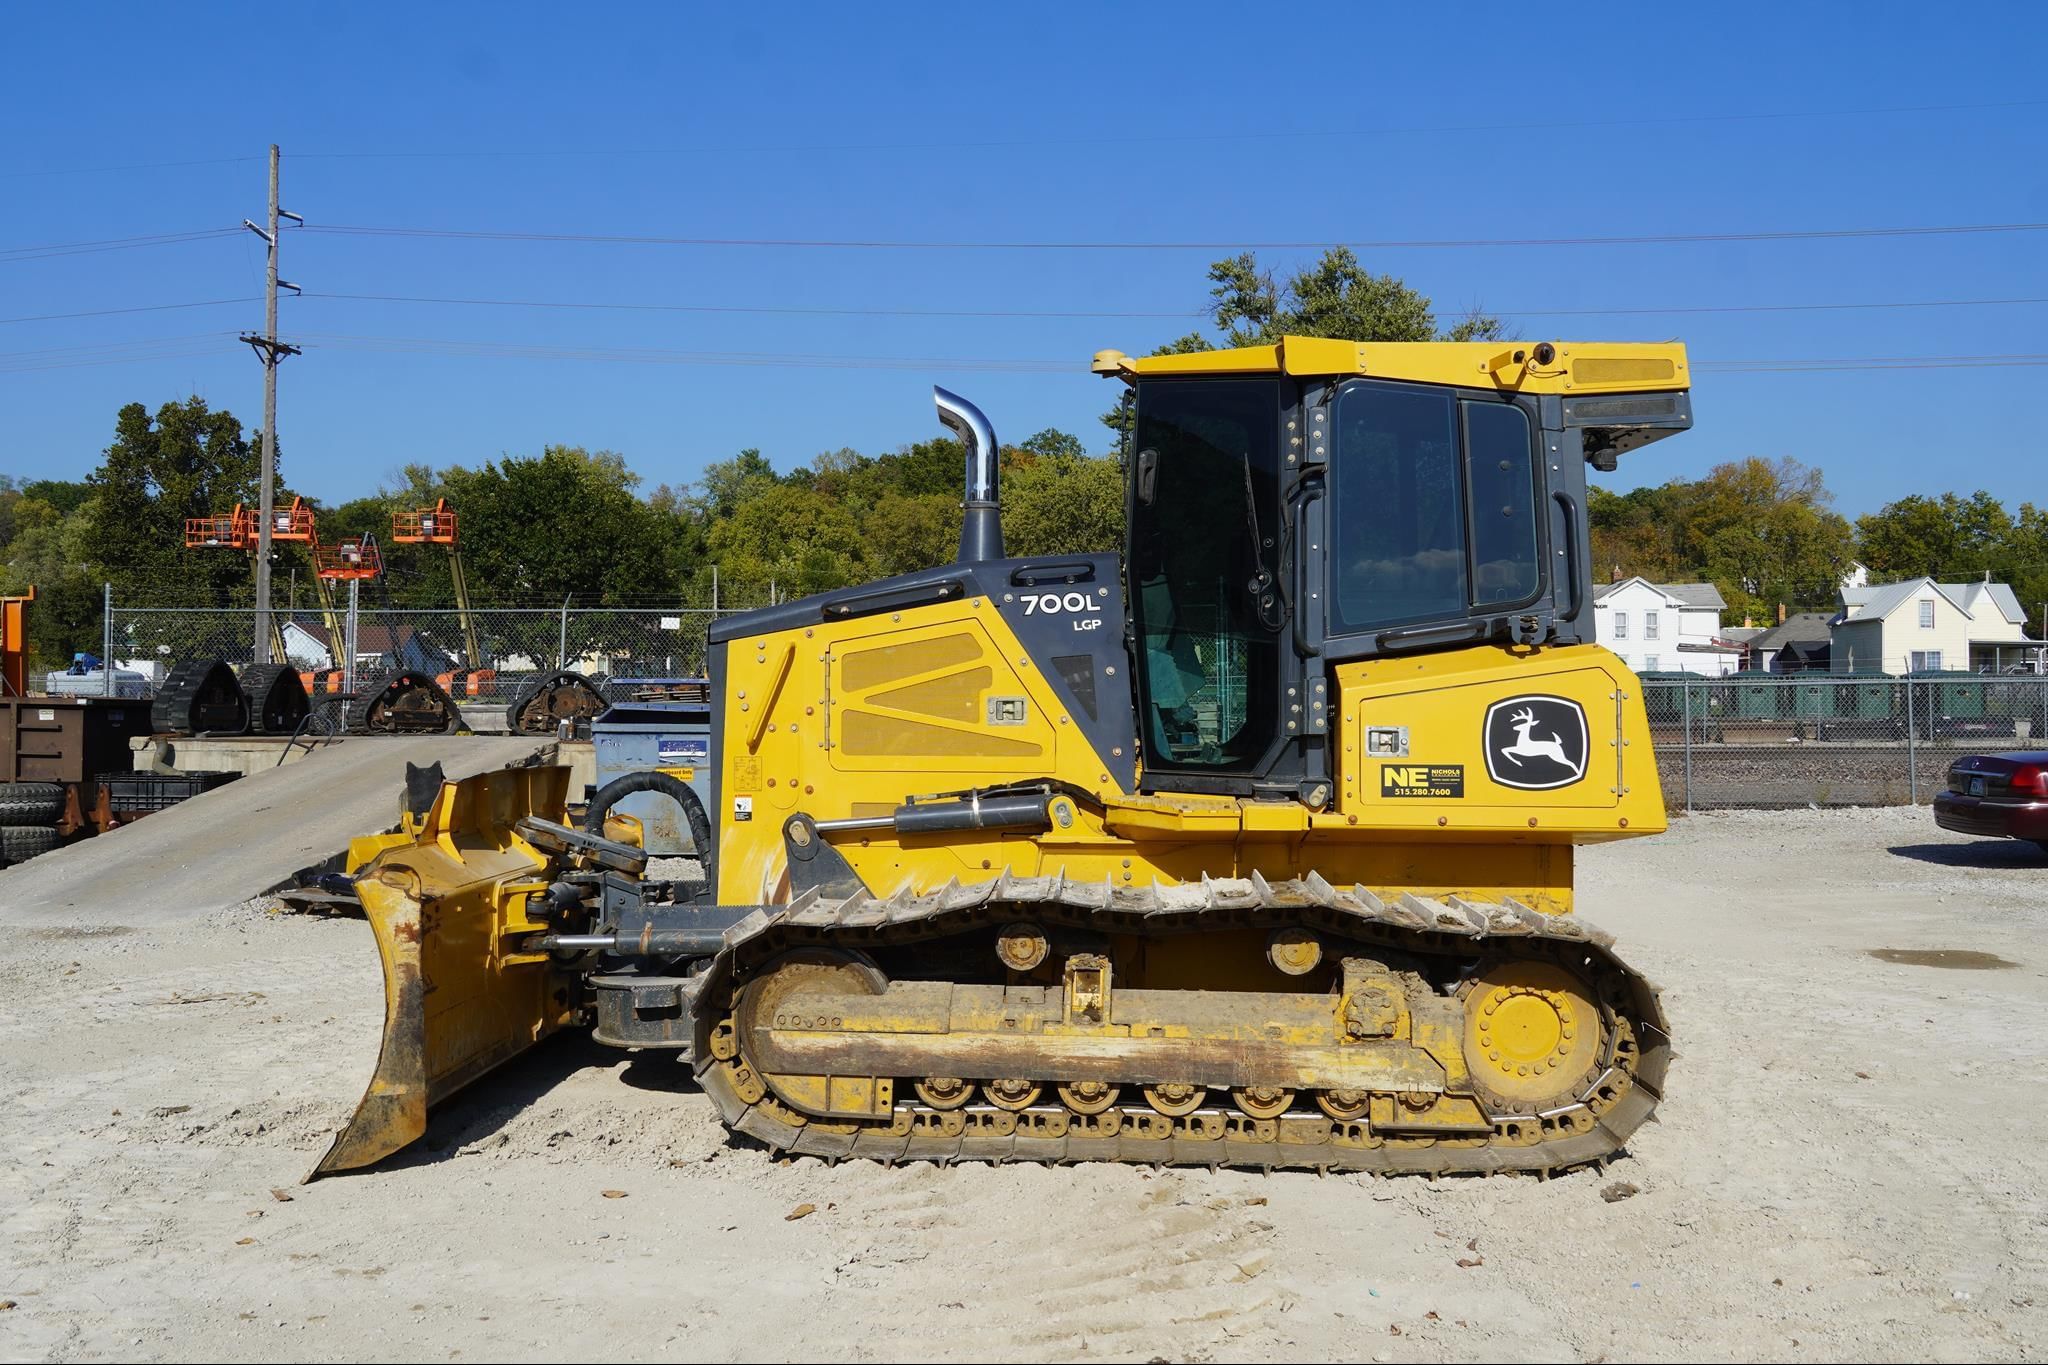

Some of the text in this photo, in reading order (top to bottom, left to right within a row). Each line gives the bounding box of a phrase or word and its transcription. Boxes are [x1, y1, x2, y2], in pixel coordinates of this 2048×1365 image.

[1020, 592, 1101, 616] 700L
[1073, 619, 1102, 631] LGP
[1384, 767, 1429, 787] NE
[1394, 788, 1451, 796] 515.280.7600
